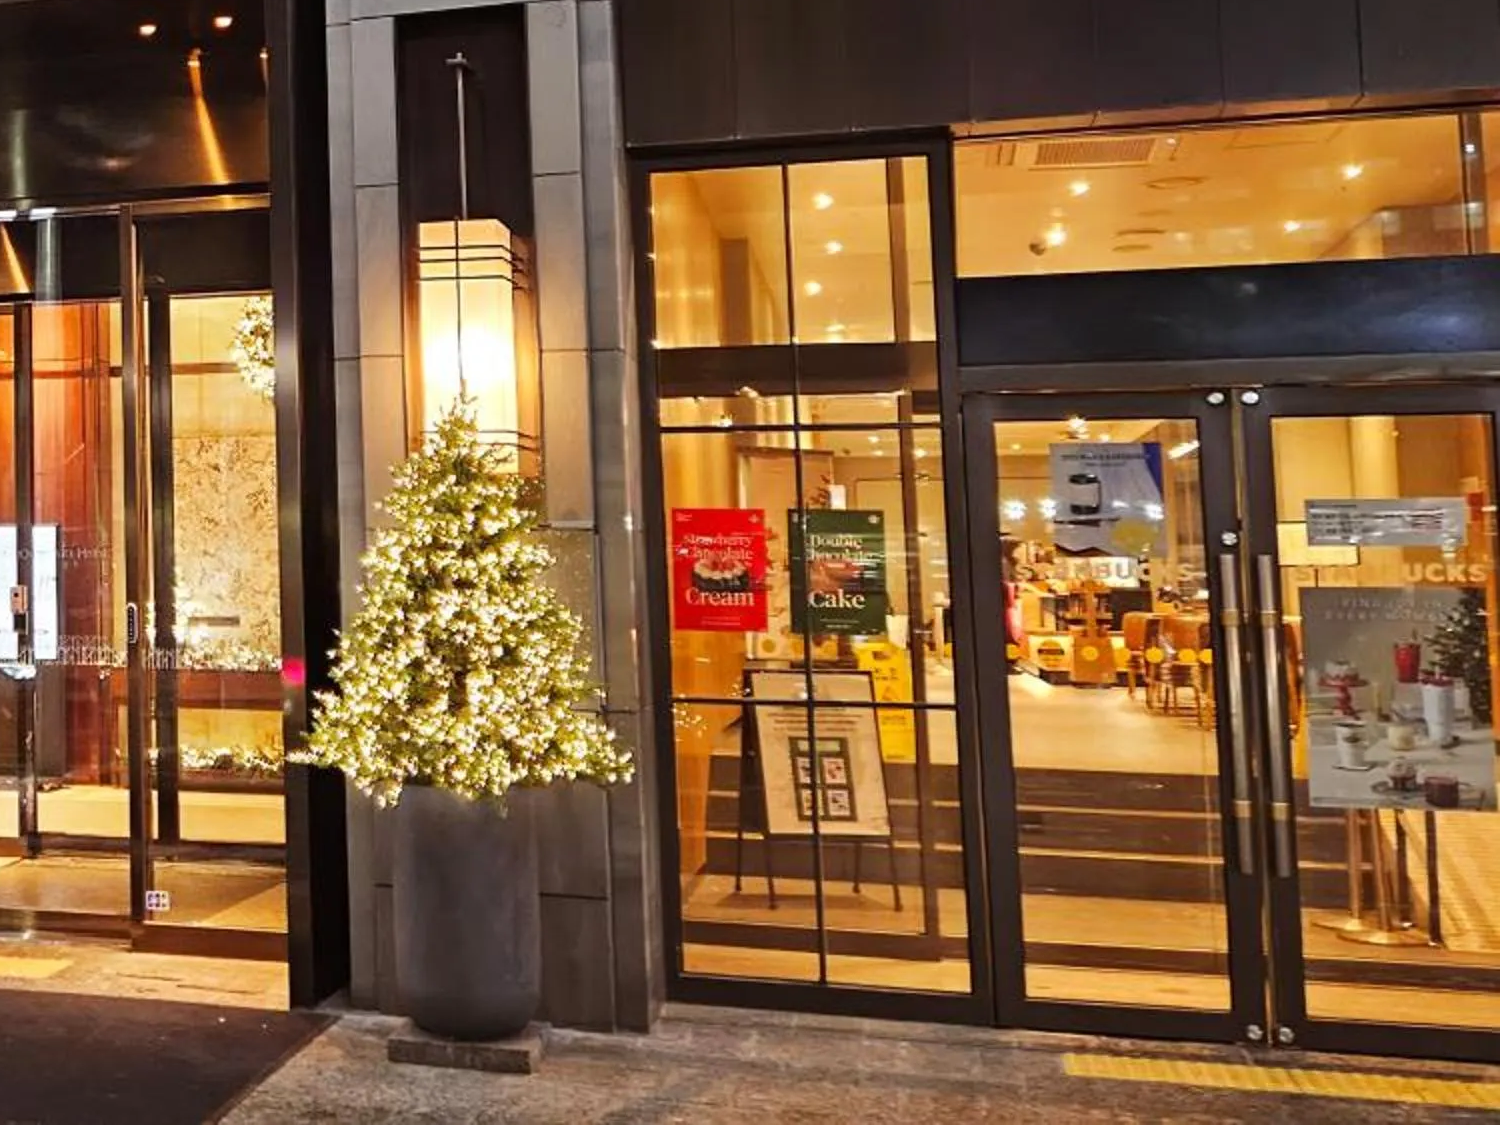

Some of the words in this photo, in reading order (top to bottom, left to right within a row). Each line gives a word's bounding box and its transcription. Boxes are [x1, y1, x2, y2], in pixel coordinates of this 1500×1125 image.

[1294, 562, 1488, 583] STAUCKS
[685, 588, 755, 606] Cream
[808, 589, 866, 609] Cake
